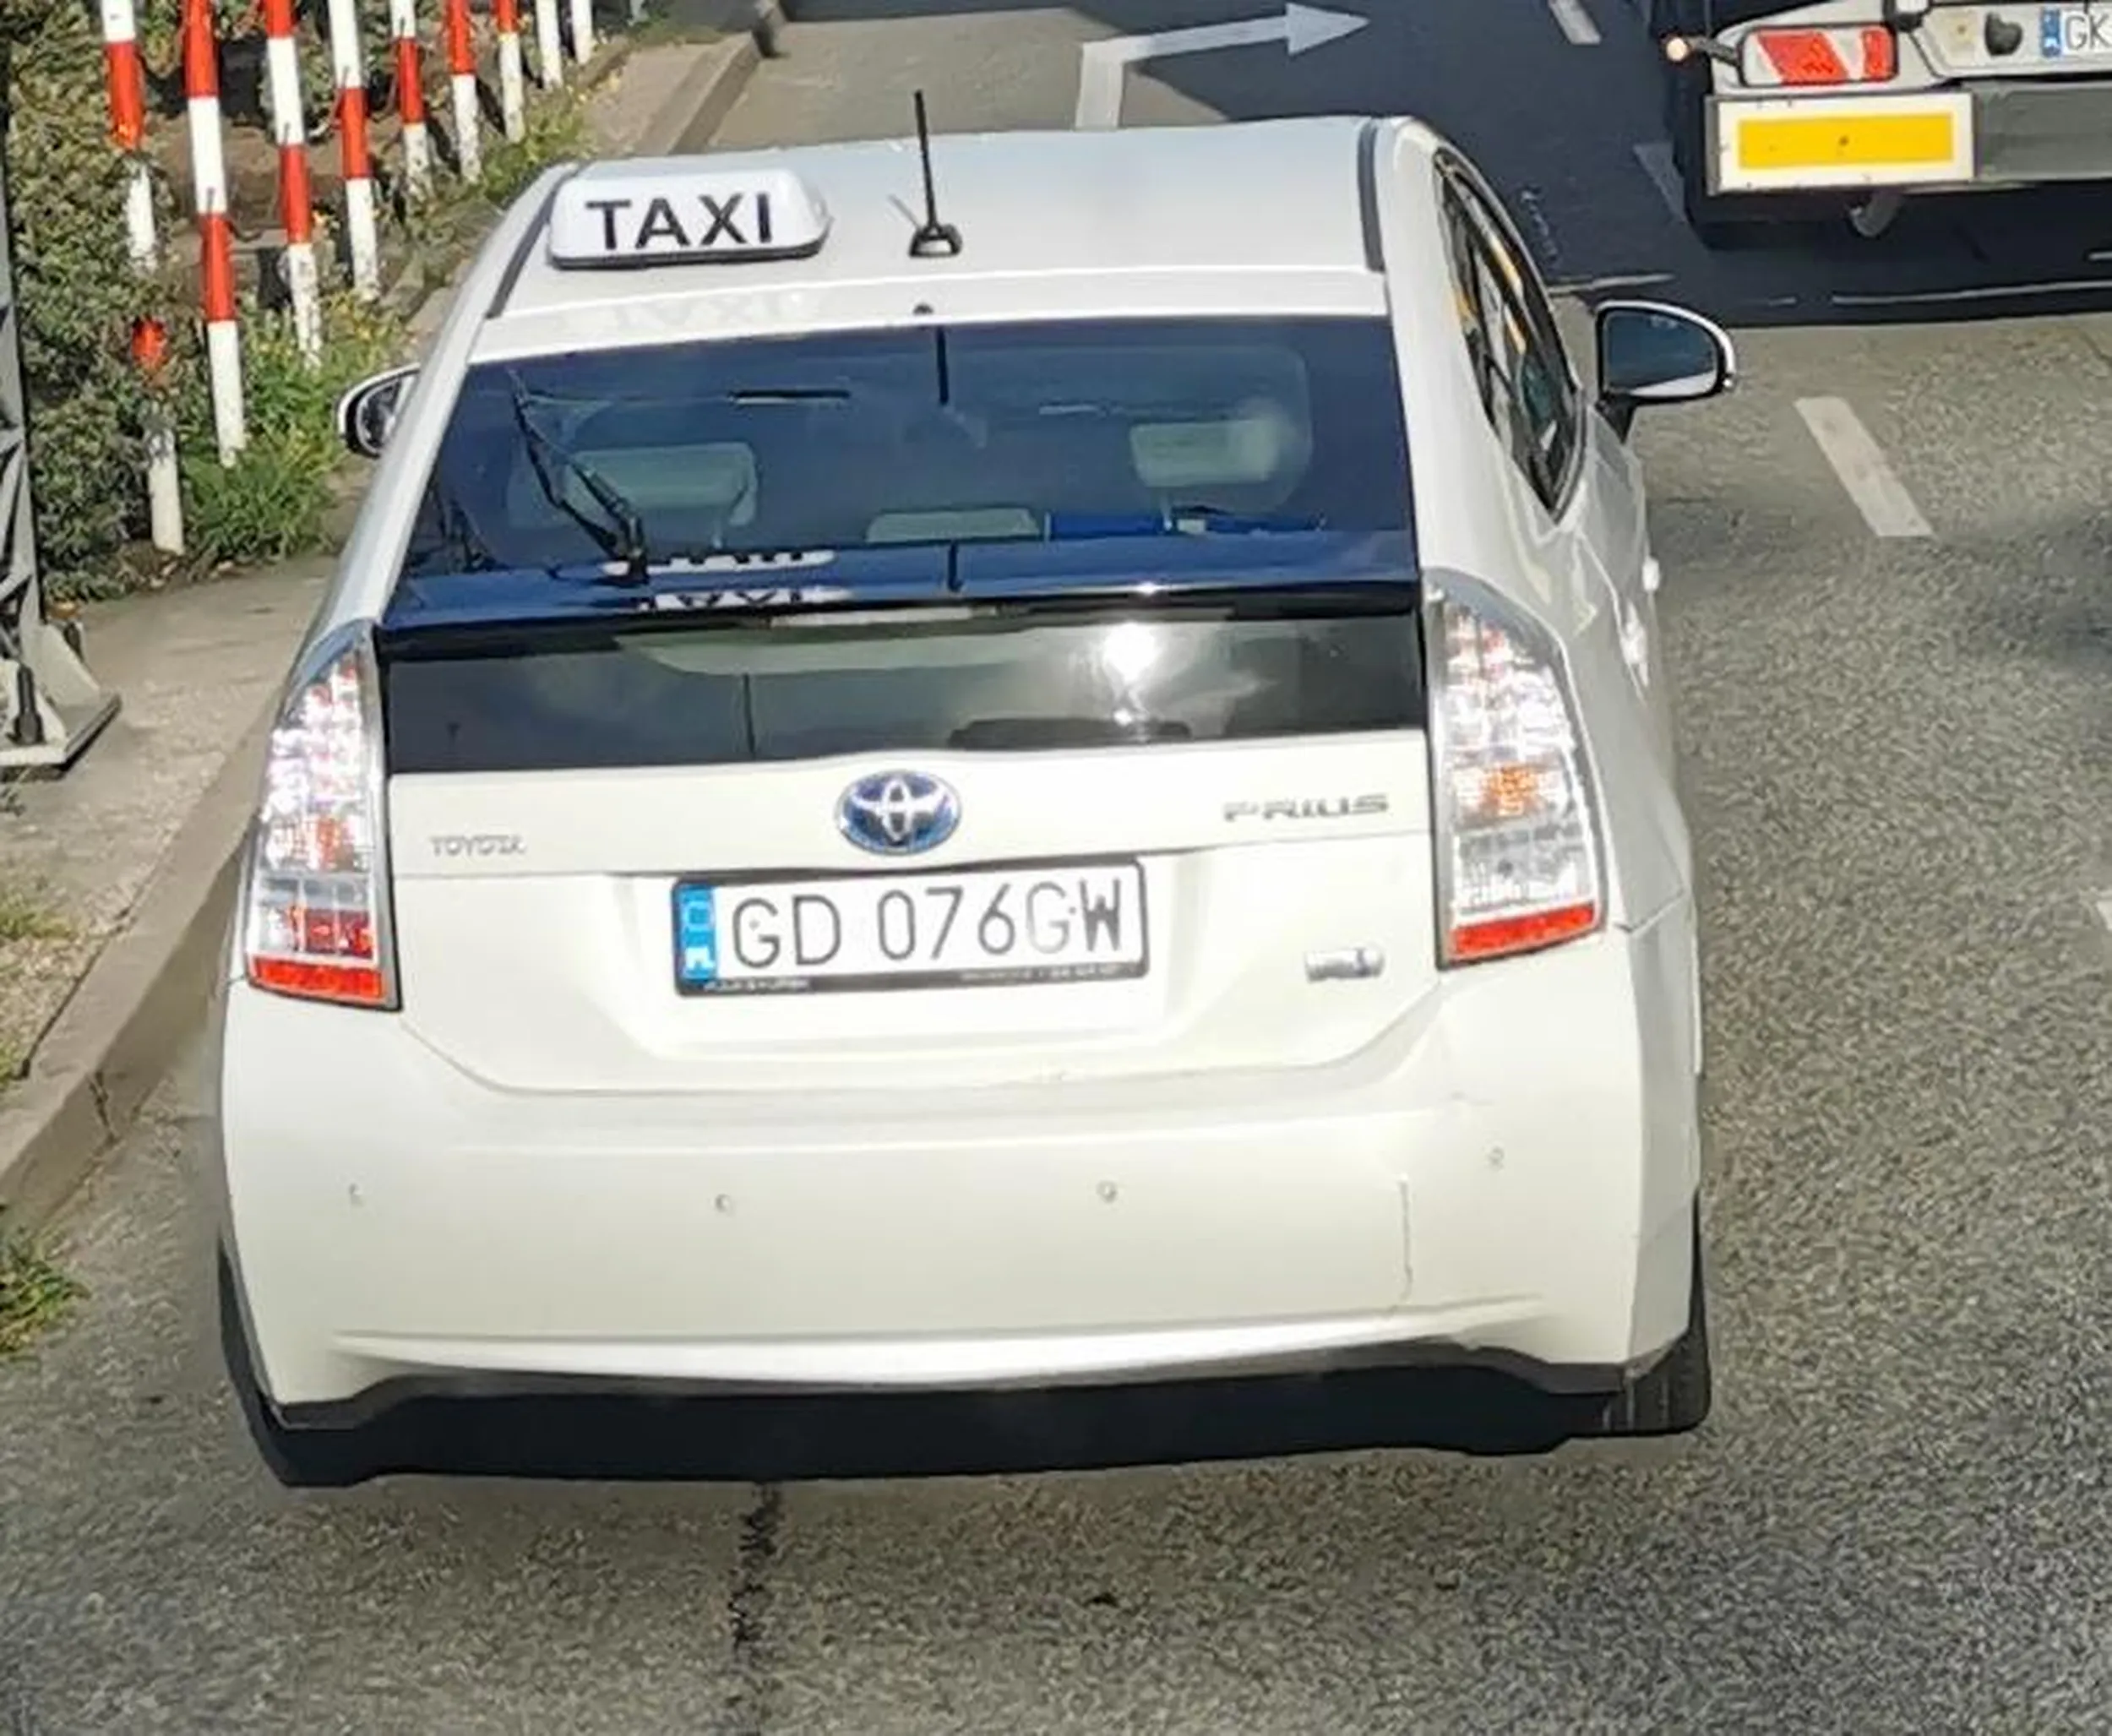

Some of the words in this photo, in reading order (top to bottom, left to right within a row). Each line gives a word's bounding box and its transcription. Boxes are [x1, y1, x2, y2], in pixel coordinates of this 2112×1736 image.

[585, 192, 773, 250] TAXI
[1223, 792, 1389, 822] PRIUS
[429, 834, 526, 857] TOYOTA
[732, 895, 841, 968] GD
[877, 878, 1121, 961] 076GW
